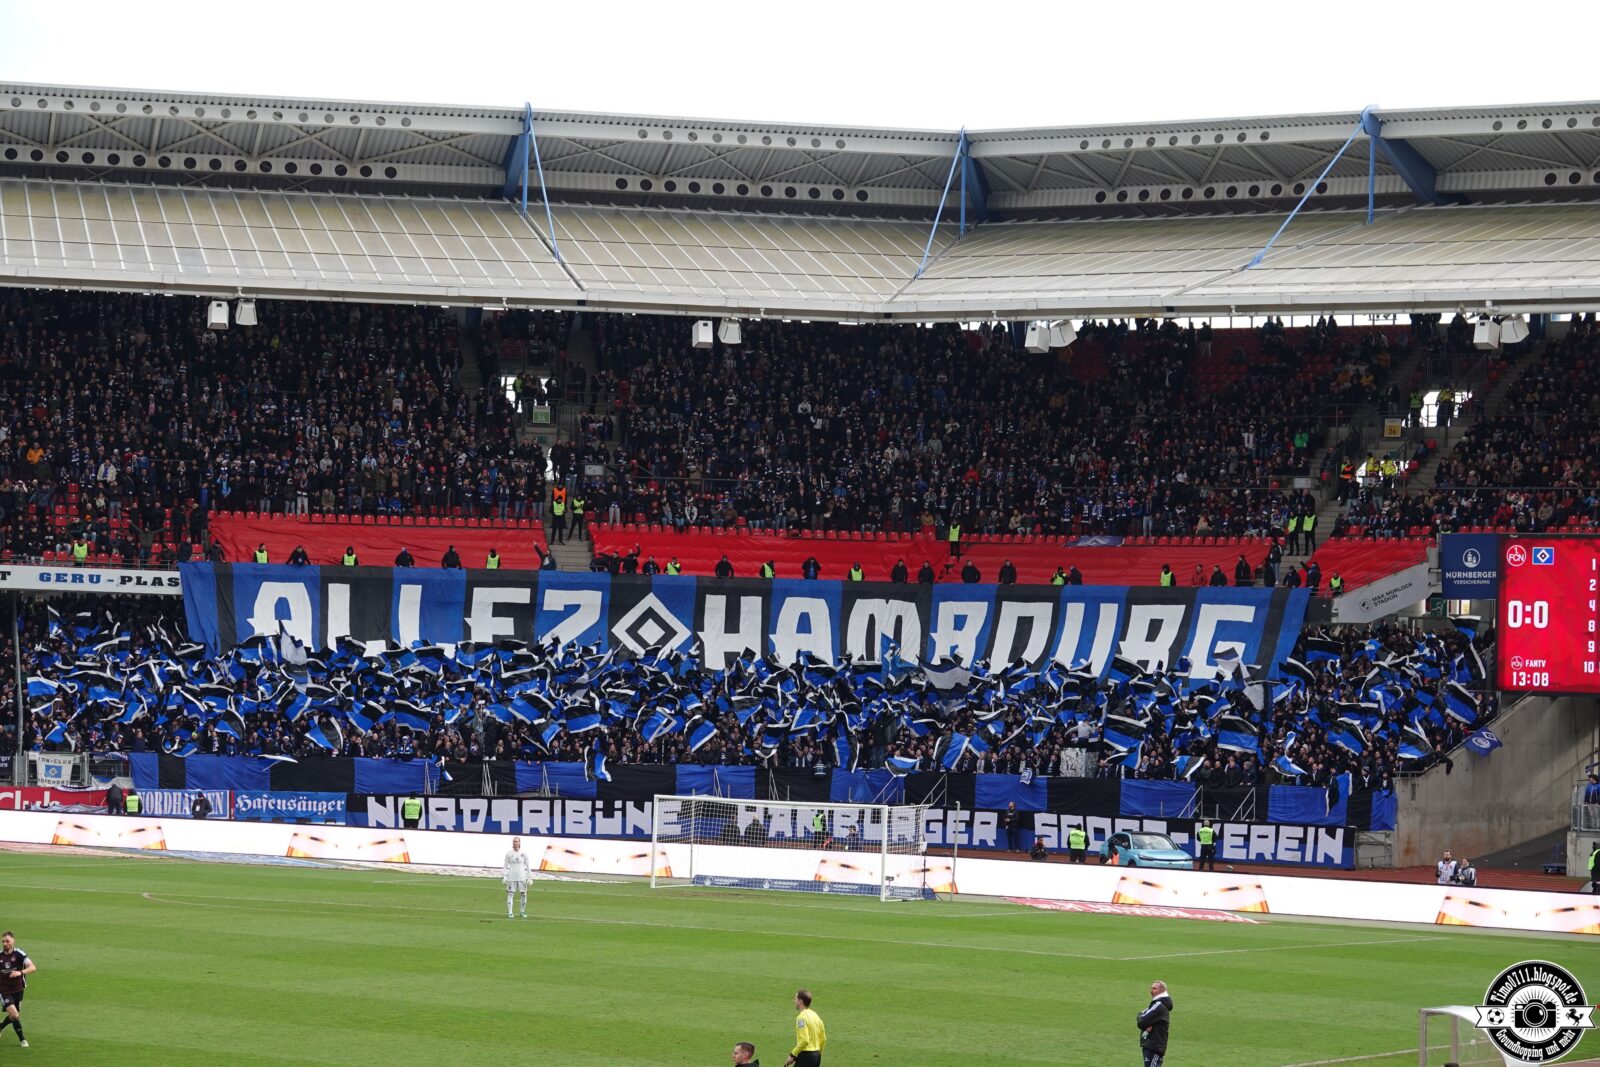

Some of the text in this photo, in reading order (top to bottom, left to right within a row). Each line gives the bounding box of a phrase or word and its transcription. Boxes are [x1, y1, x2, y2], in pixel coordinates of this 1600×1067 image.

[1591, 558, 1597, 571] 1
[1589, 579, 1597, 591] 2
[1372, 582, 1413, 602] MAX MORLOCK
[1374, 594, 1398, 607] STADION
[1589, 600, 1596, 611] 4
[1508, 600, 1549, 628] 0:0
[1588, 620, 1596, 632] 8
[1588, 641, 1595, 653] 9
[1584, 661, 1595, 673] 10
[1513, 672, 1549, 686] 13:08
[137, 790, 224, 815] NORDHAEN
[235, 793, 345, 816] Hafensänger
